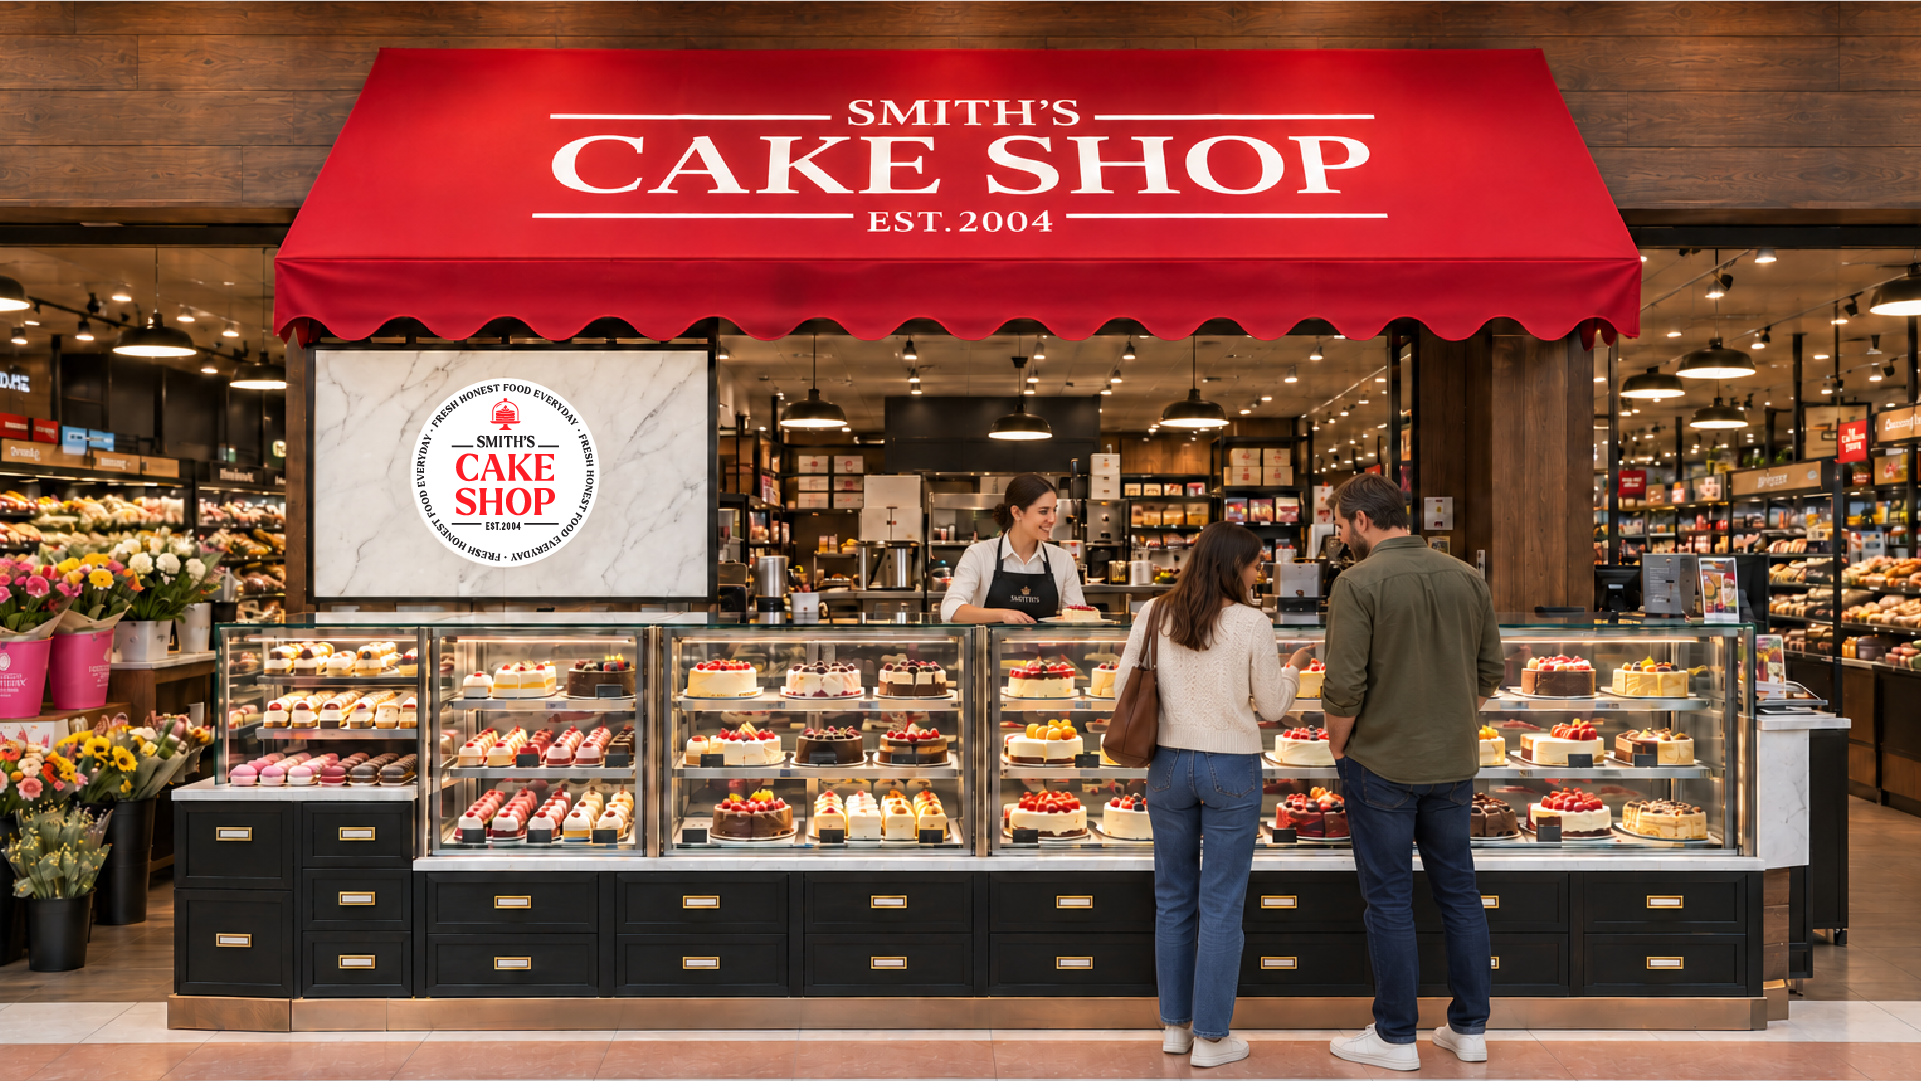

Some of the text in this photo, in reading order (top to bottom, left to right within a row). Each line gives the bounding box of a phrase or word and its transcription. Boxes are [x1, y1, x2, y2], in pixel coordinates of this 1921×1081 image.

[848, 100, 1080, 126] SMITH'S
[552, 135, 1370, 194] CAKE SHOP
[432, 384, 578, 427] FRESH HONEST FOOD EVERYDAY
[477, 436, 535, 448] SMITH'S
[456, 453, 554, 481] CAKE
[417, 434, 500, 561] FRESH HONEST FOOD EVERYDAY
[456, 488, 555, 515] SHOP
[511, 434, 594, 561] FRESH HONEST FOOD EVERYDAY
[486, 522, 521, 530] EST.2004
